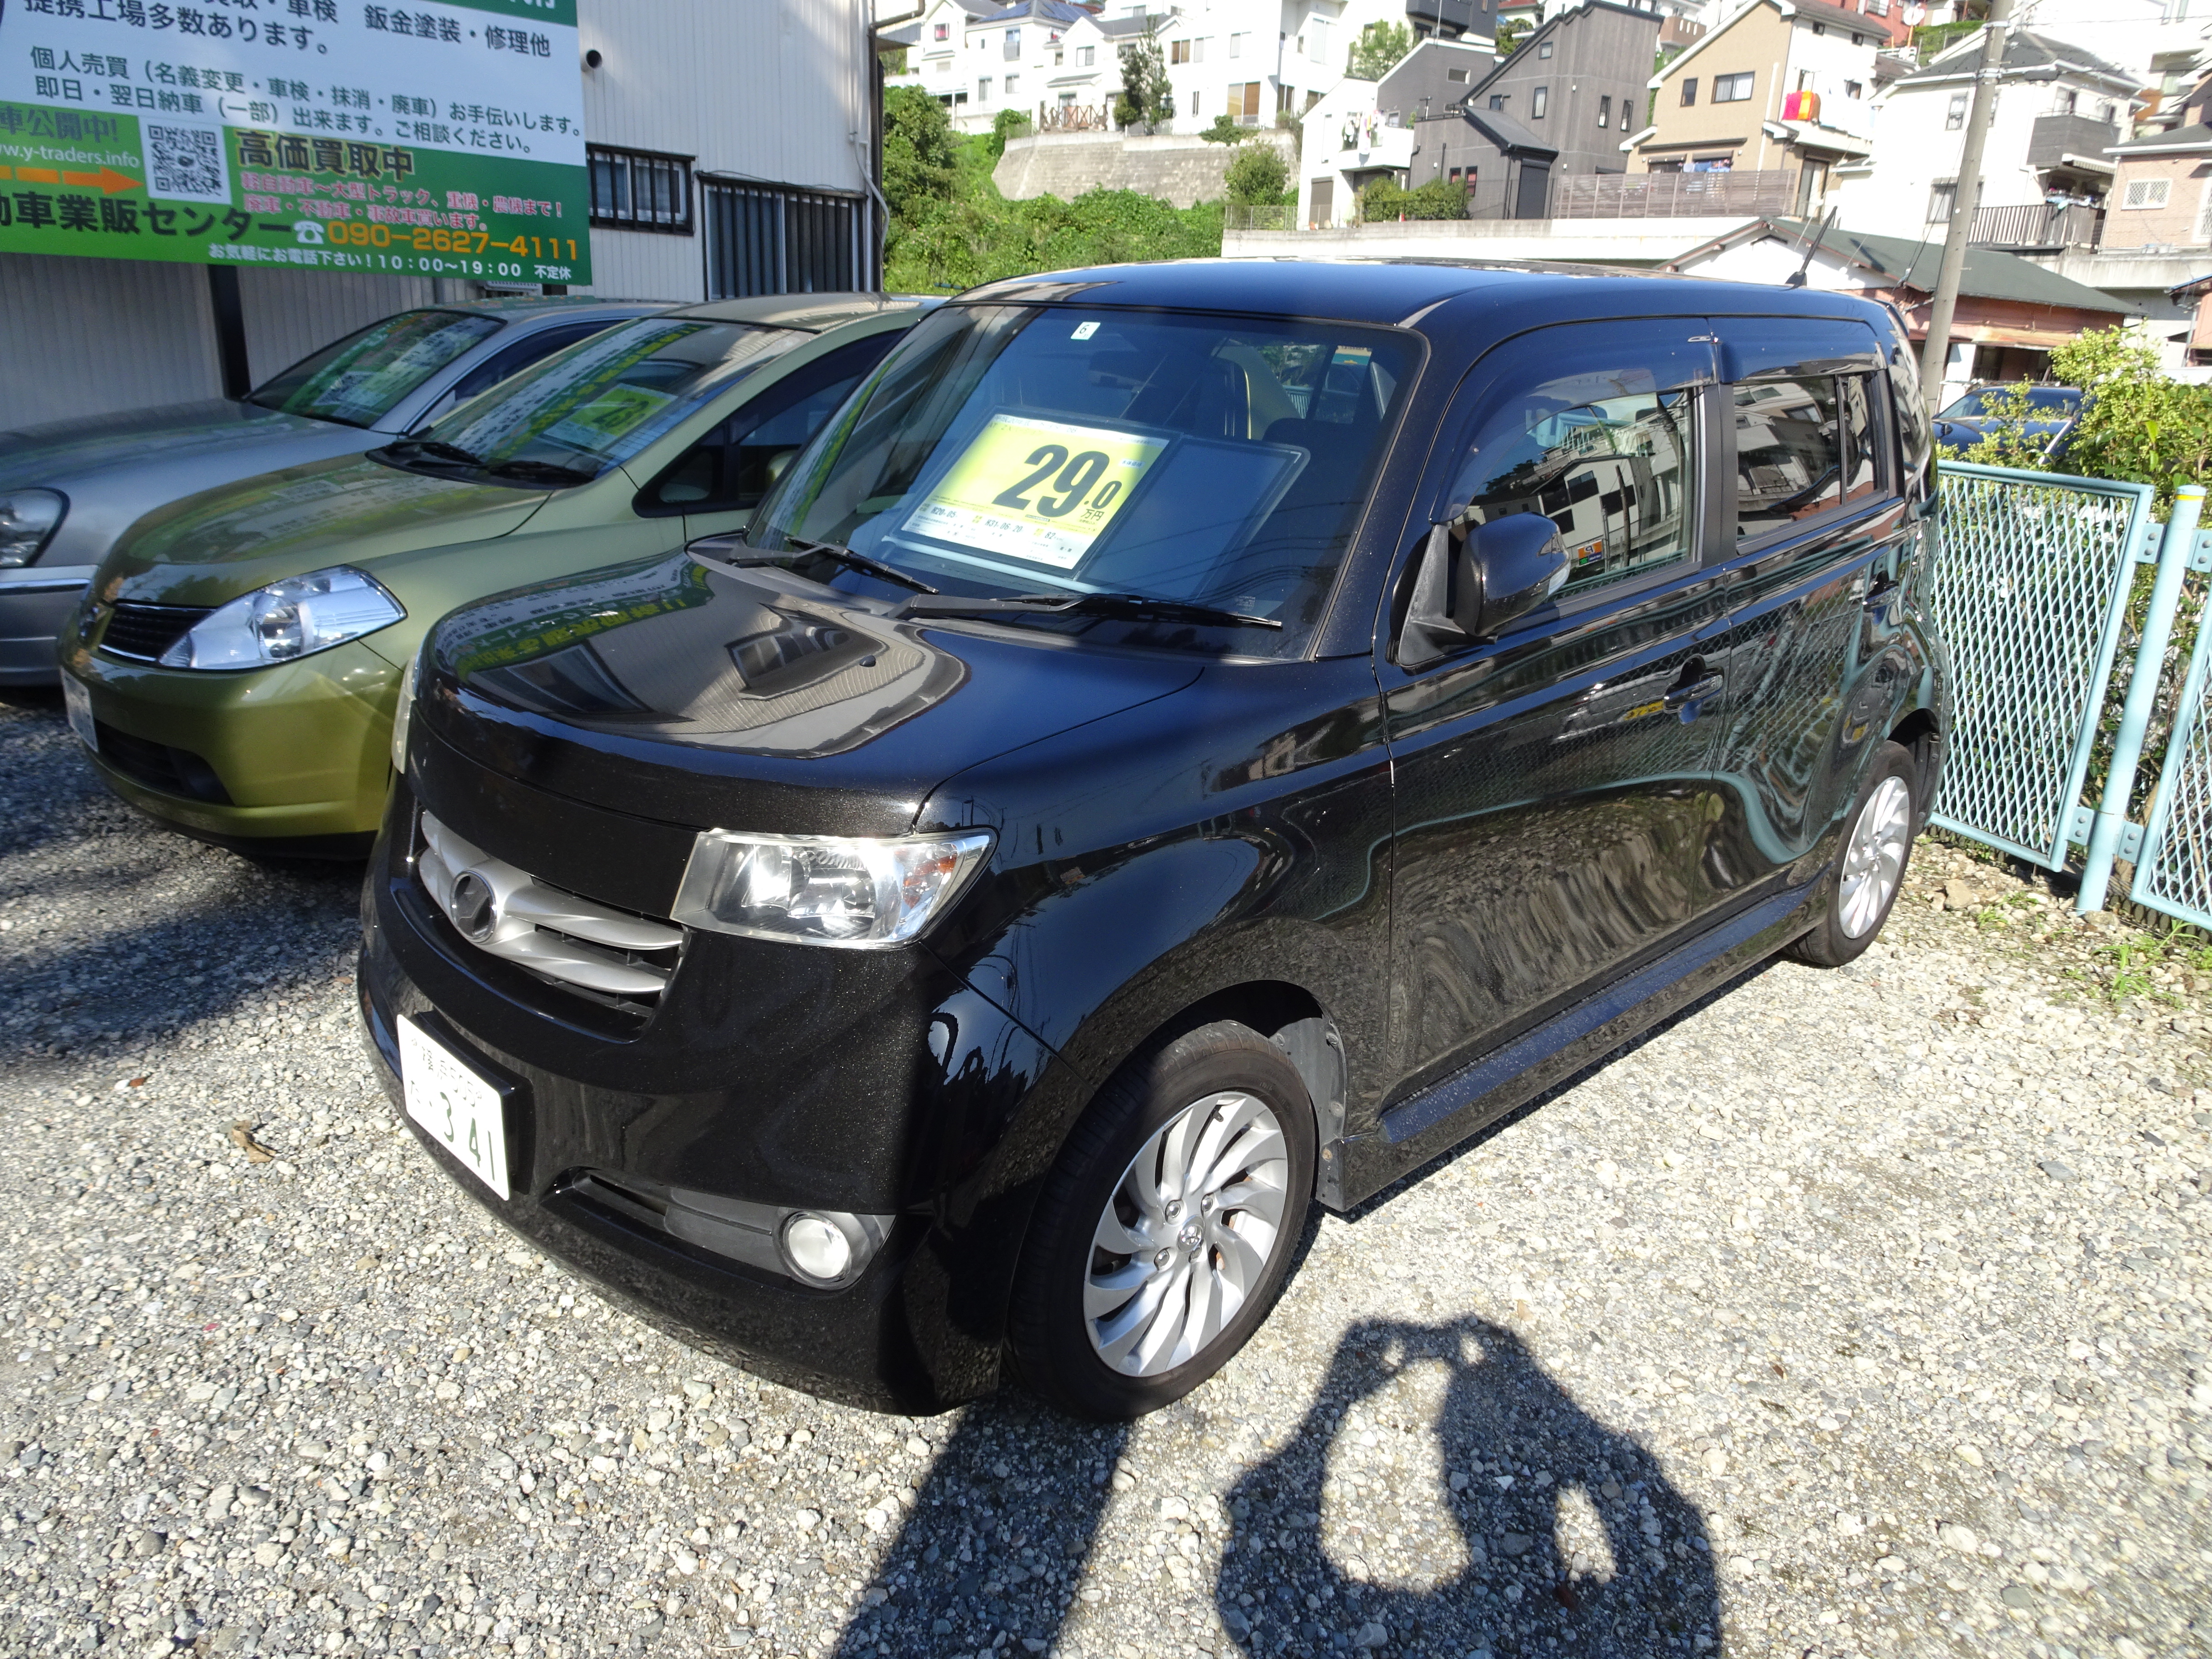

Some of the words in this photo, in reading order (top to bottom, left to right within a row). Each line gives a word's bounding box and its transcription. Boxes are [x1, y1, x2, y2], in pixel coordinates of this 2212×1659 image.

[0, 144, 140, 168] w.y-traders.info
[235, 130, 415, 182] 高価買取中
[327, 221, 578, 261] 090-2627-4111
[534, 265, 572, 280] 不定休
[1079, 324, 1090, 334] 6
[1080, 509, 1105, 521] 万円
